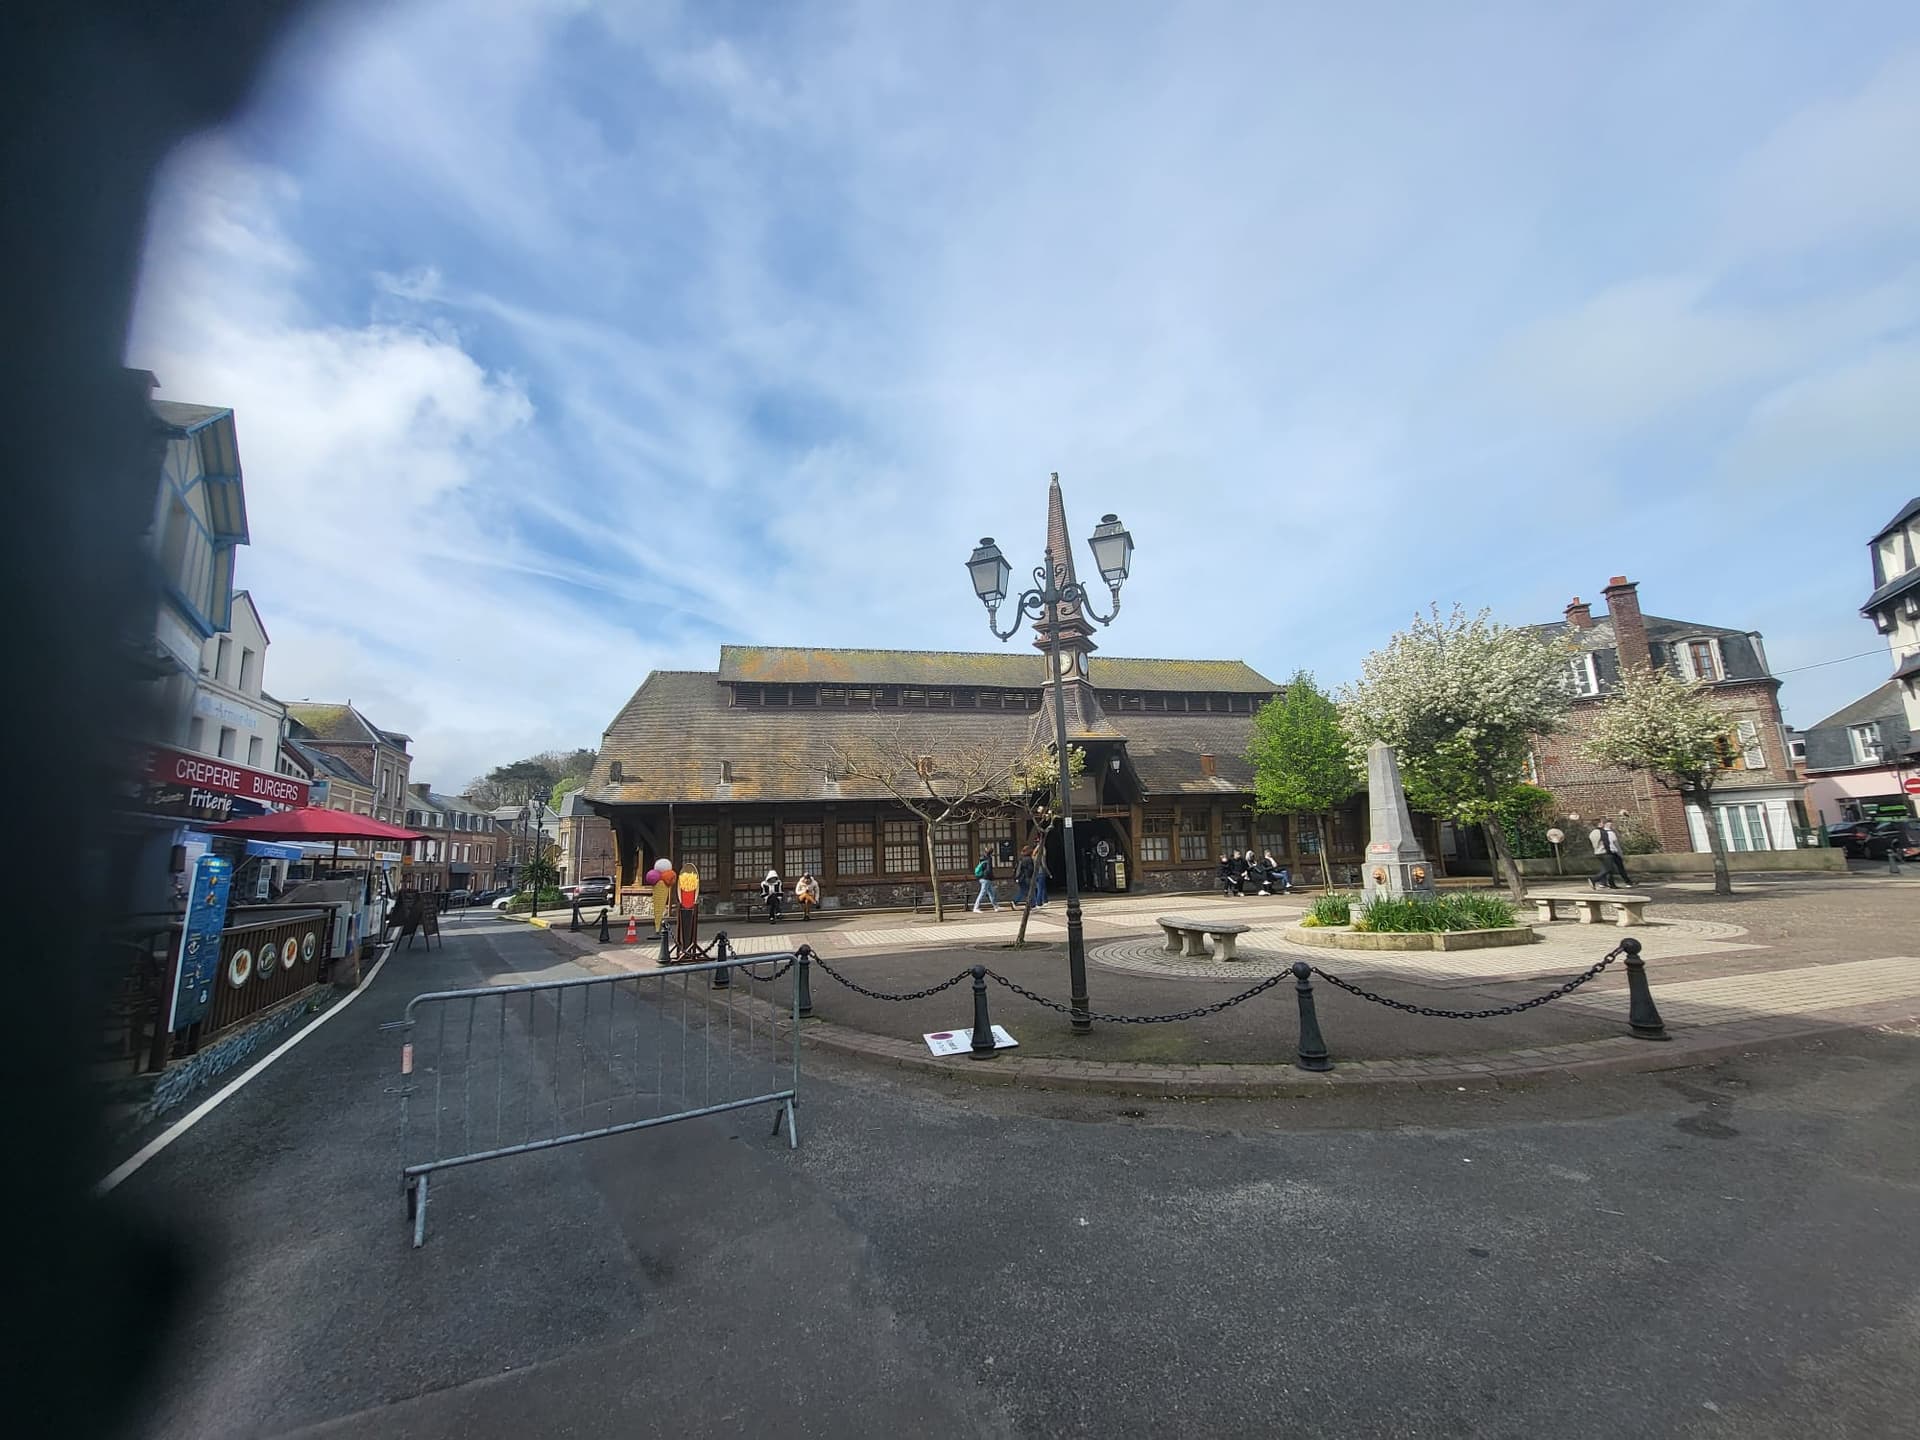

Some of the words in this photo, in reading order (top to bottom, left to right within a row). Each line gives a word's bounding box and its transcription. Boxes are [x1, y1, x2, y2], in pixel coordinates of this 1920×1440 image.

[176, 758, 240, 790] CREPERIE
[252, 776, 299, 801] BURGERS
[188, 787, 233, 812] Friterie
